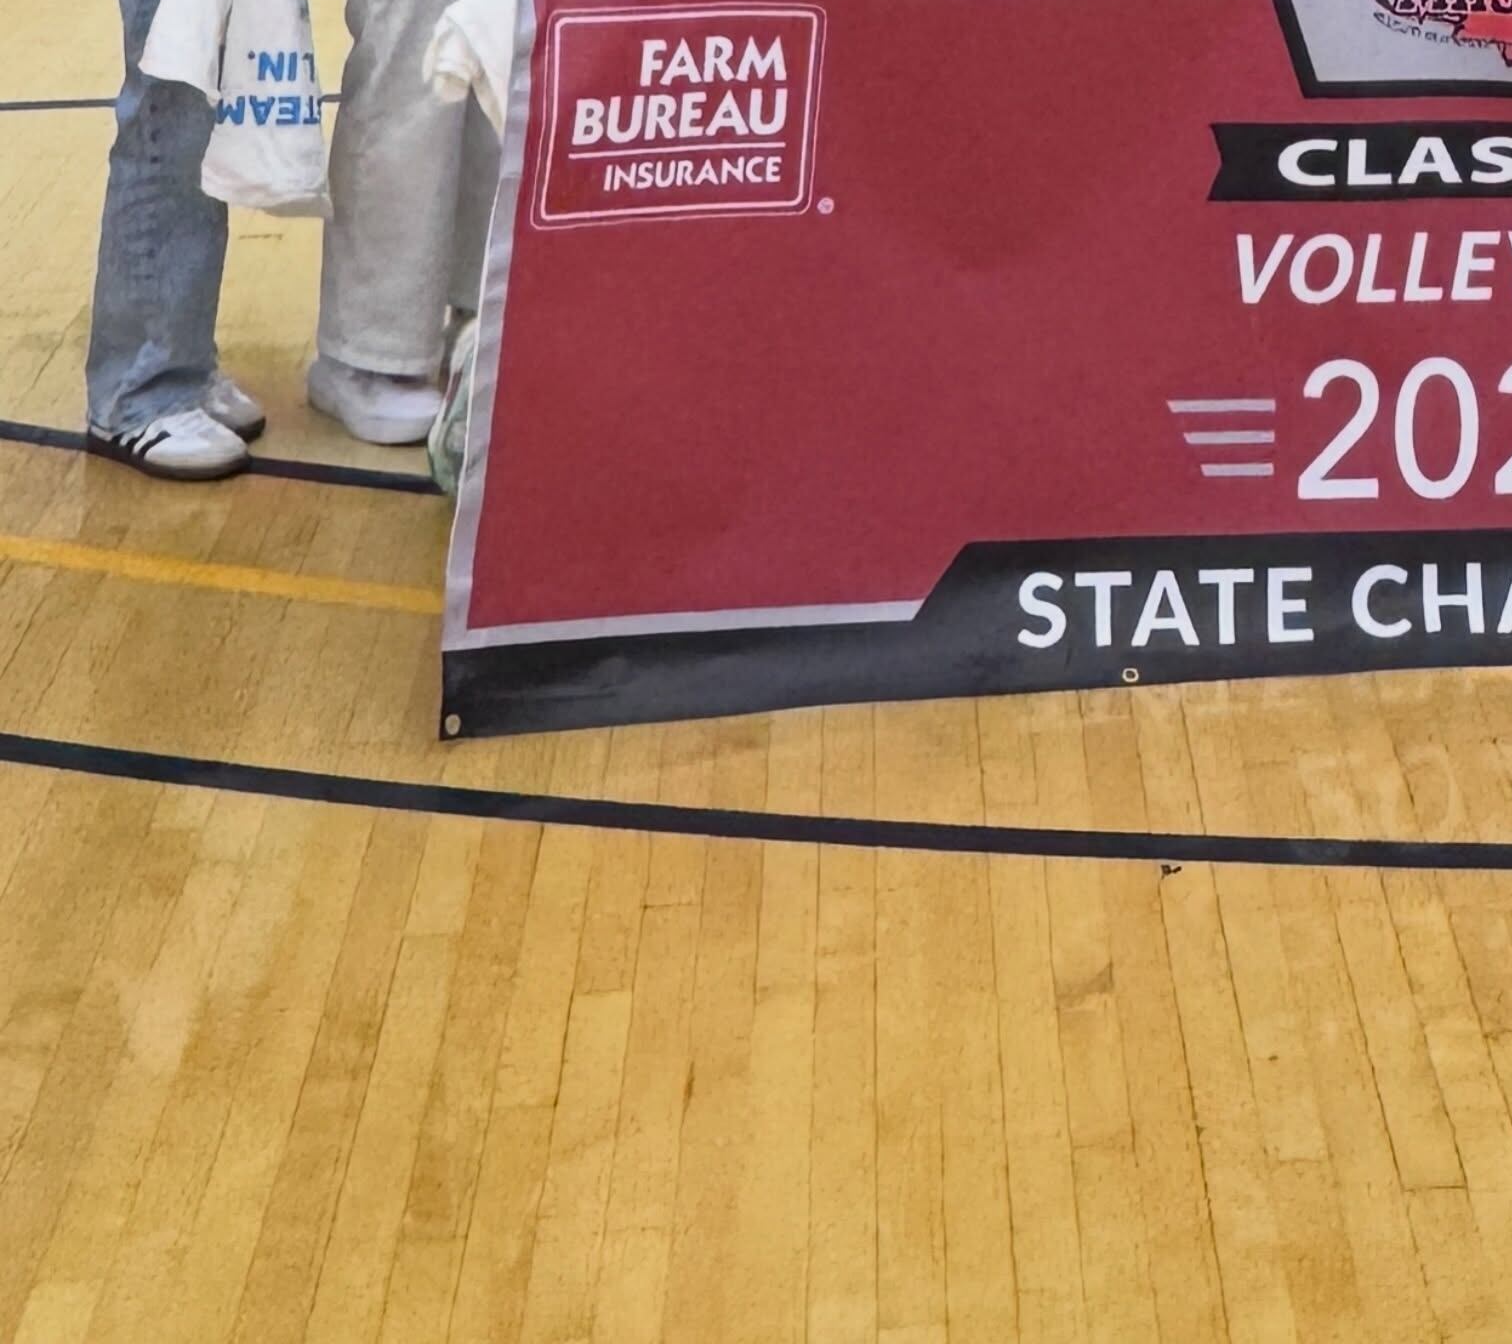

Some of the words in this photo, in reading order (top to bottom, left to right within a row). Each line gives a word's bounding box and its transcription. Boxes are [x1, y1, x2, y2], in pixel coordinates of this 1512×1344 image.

[639, 34, 787, 87] FARM
[571, 87, 788, 146] BUREAU
[603, 155, 783, 192] INSURANCE
[1016, 565, 1315, 650] STATE
